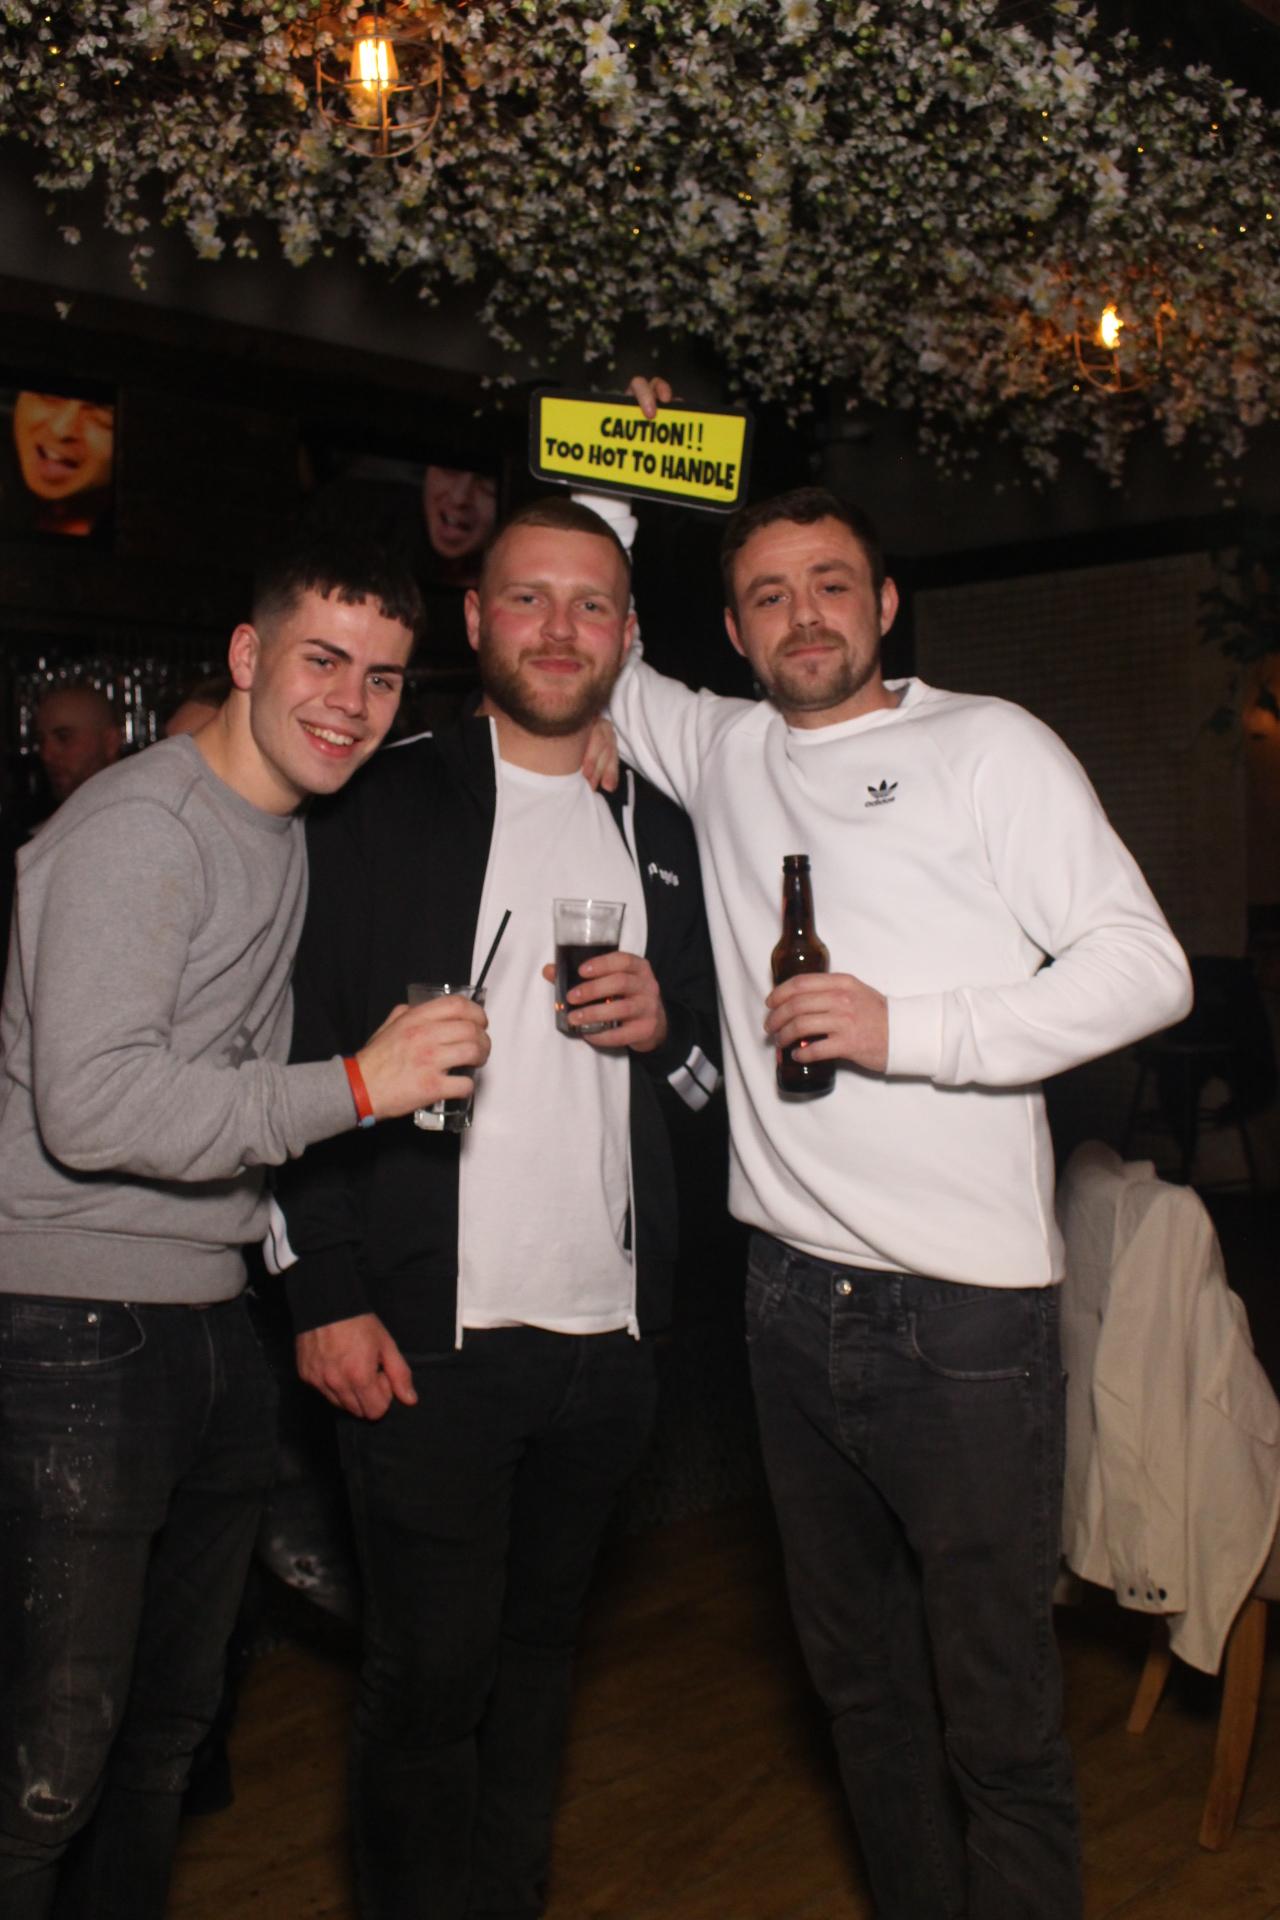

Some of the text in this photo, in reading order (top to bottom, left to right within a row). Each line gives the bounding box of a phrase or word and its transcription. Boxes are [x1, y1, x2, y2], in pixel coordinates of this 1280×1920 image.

[600, 416, 703, 451] CAUTION!!
[545, 438, 736, 490] TOO HOT TO HANDLE
